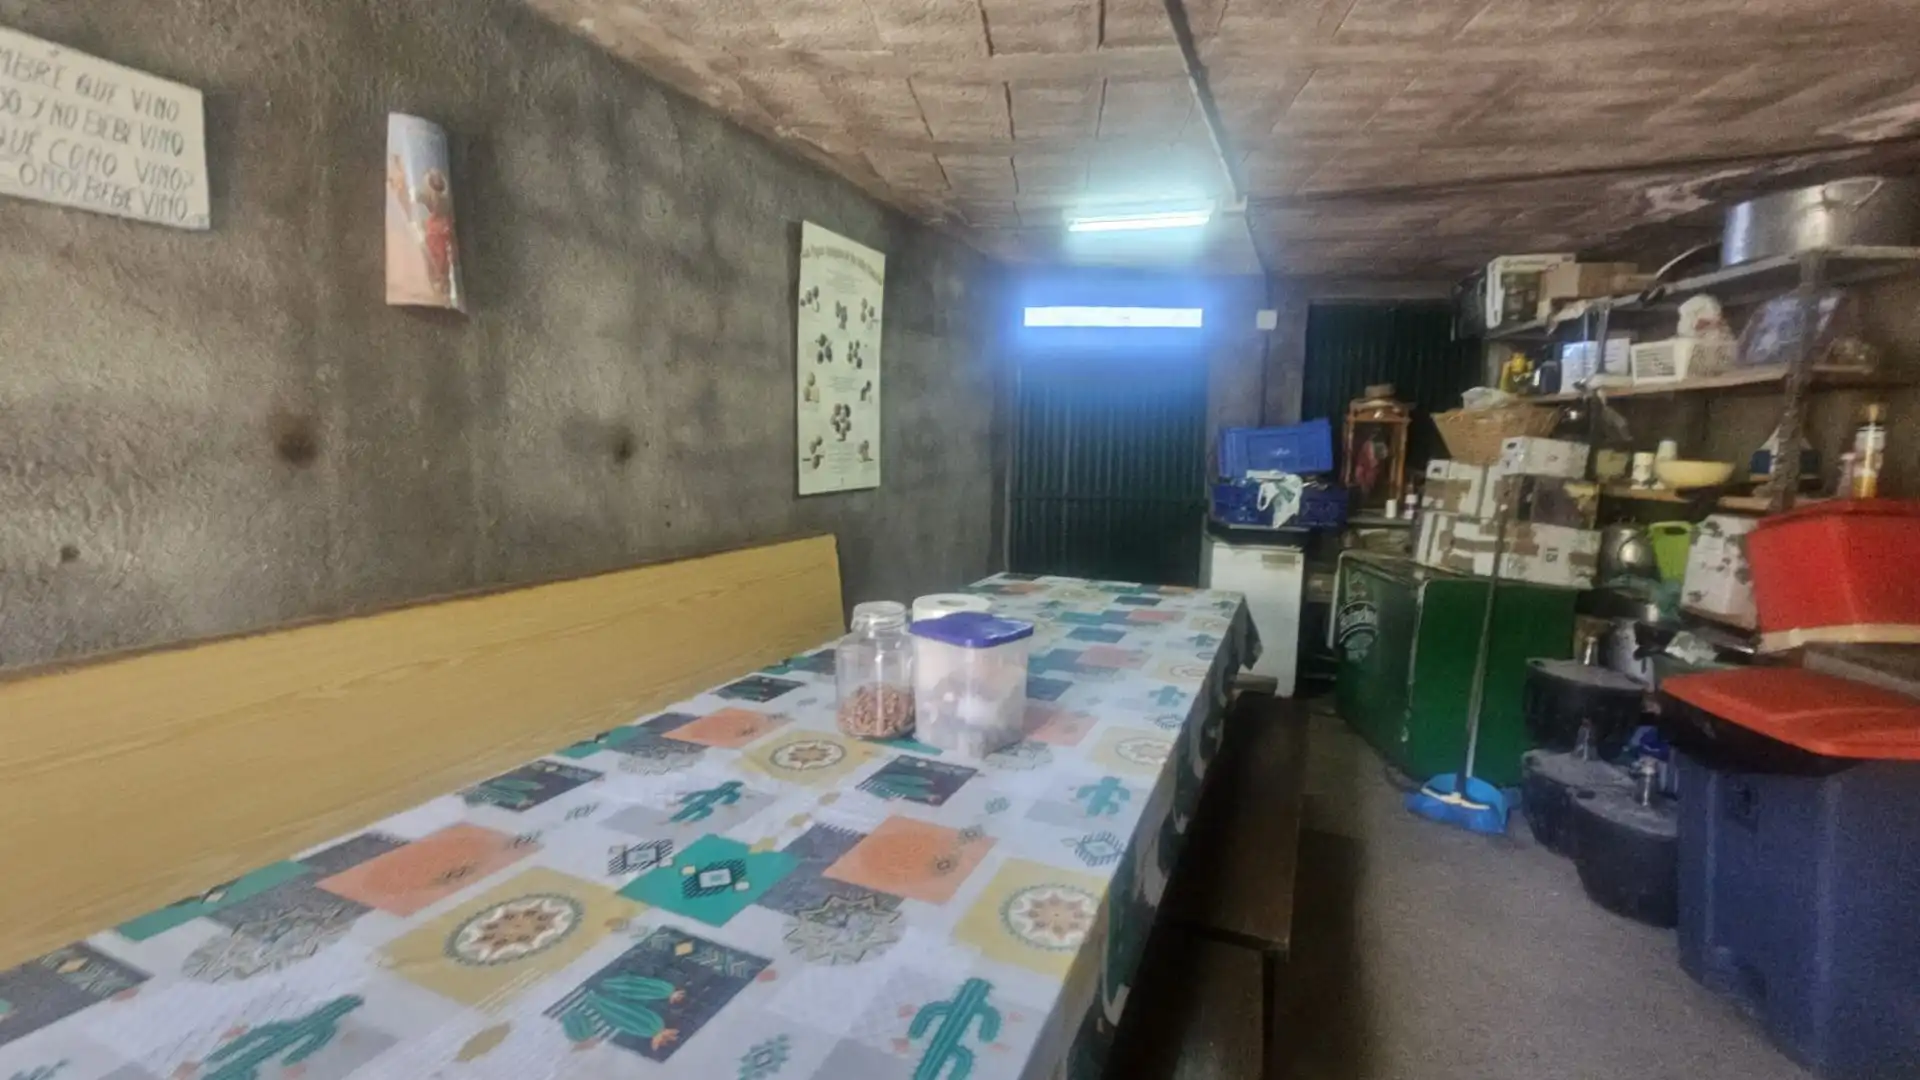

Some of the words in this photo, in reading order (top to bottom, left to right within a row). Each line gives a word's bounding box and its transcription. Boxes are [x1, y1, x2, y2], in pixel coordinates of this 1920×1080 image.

[131, 87, 180, 122] VINO
[50, 99, 78, 129] NO
[140, 122, 184, 157] VINO
[140, 189, 188, 222] VINO
